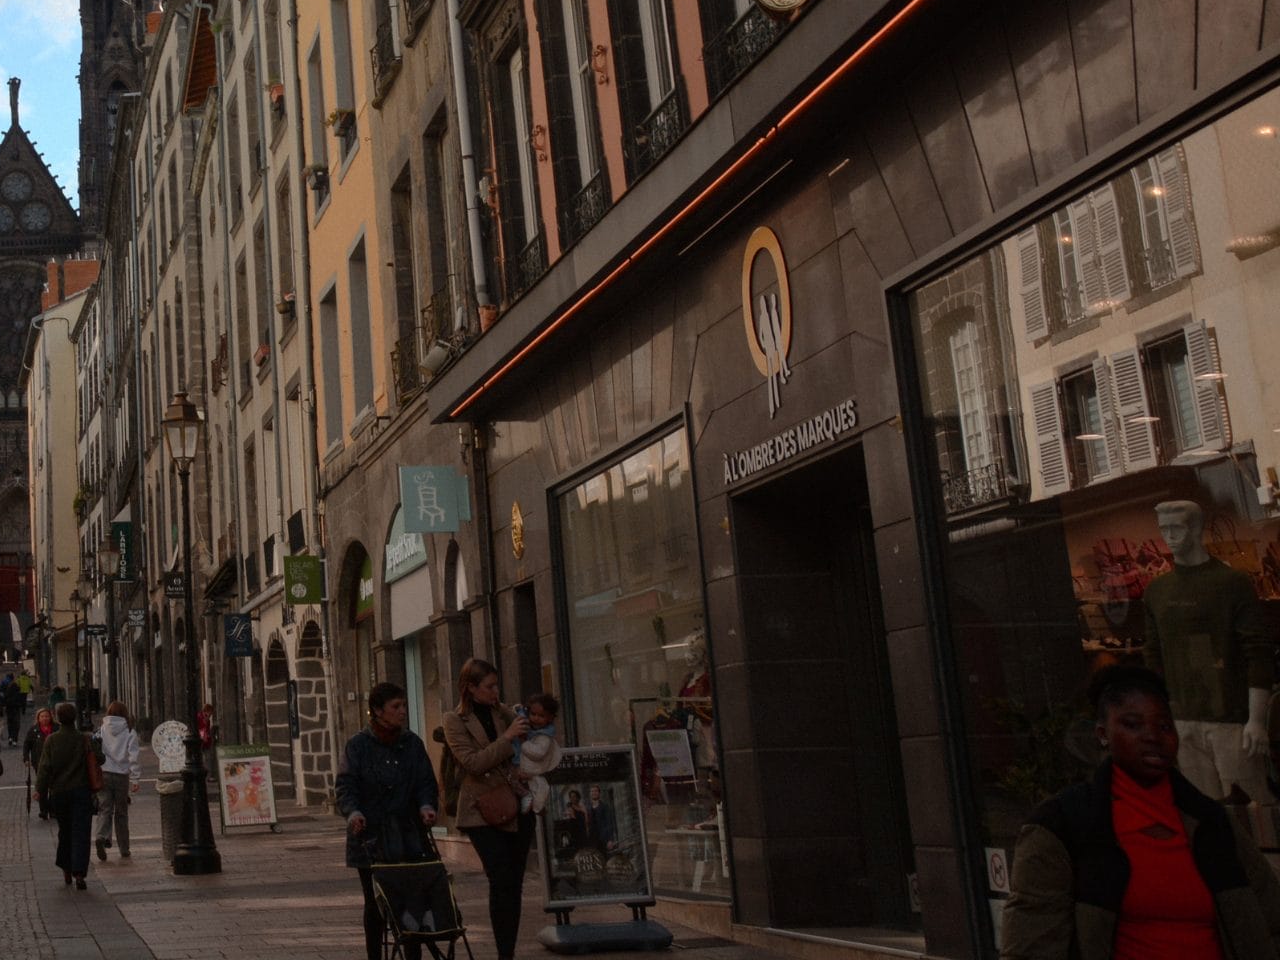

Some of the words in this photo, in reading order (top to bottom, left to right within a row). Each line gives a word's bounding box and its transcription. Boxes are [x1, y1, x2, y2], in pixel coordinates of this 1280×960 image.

[723, 452, 732, 485] À
[730, 439, 776, 481] L'OMBRE
[775, 429, 798, 463] DES
[796, 399, 857, 452] MARQUES
